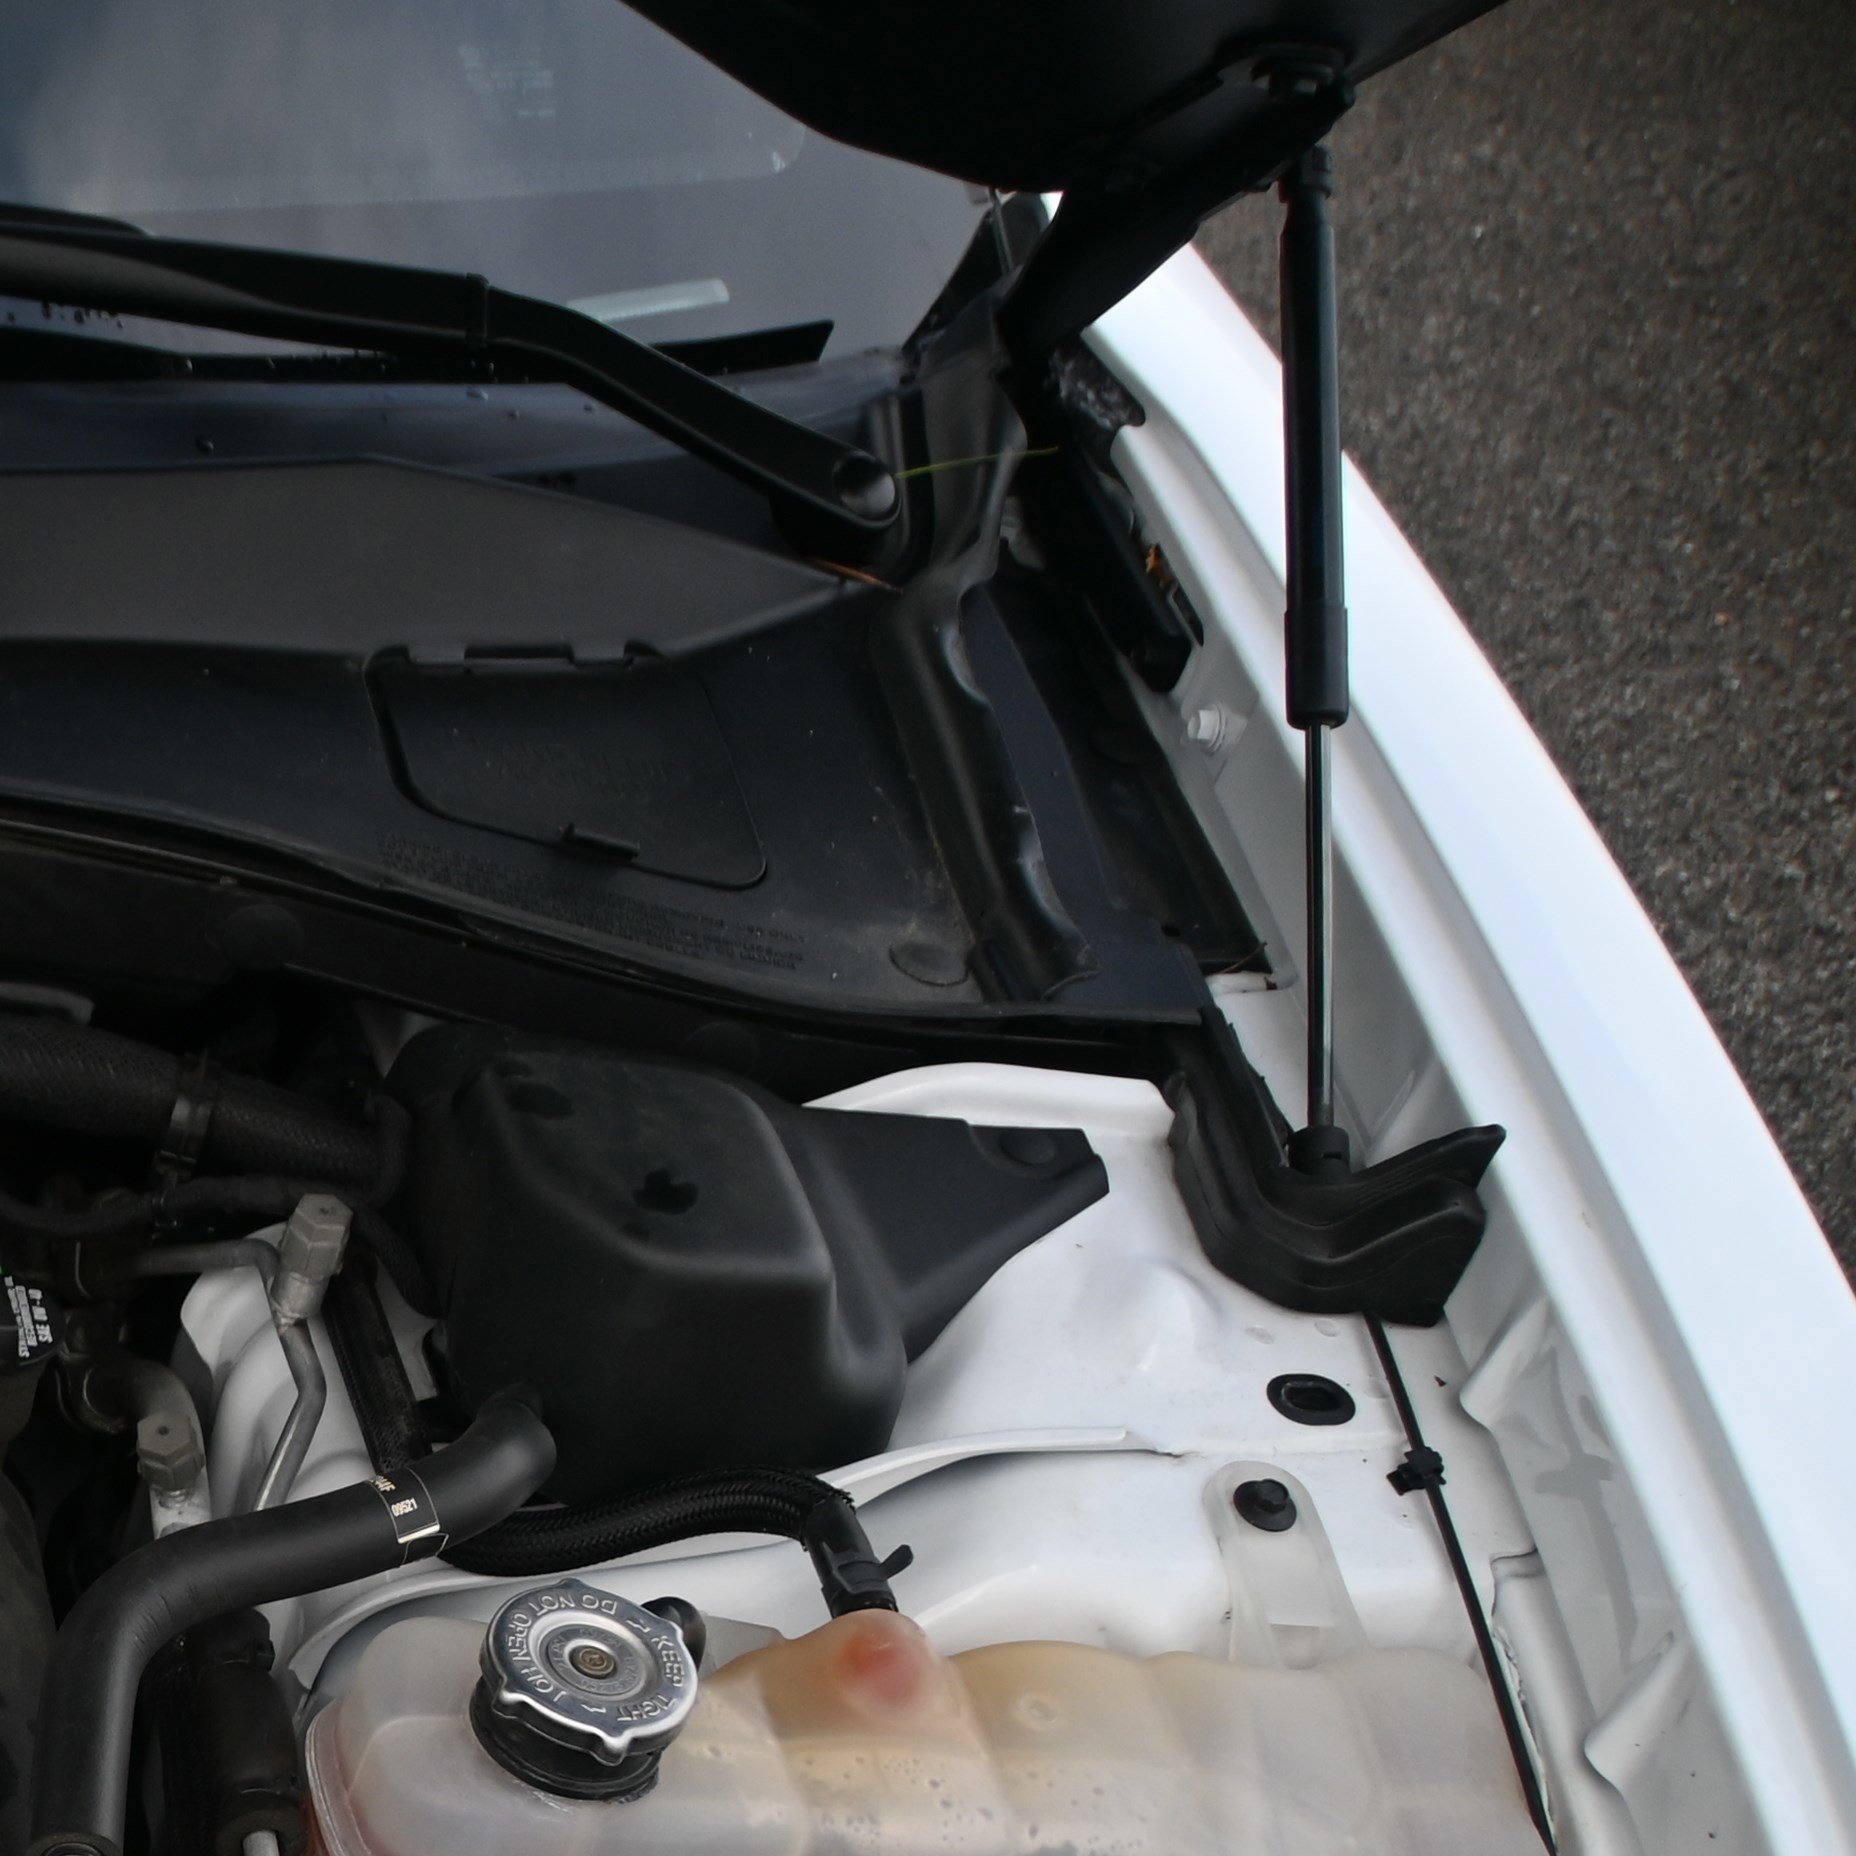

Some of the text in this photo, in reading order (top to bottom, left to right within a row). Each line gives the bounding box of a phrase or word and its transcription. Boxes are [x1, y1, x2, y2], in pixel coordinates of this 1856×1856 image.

[529, 1595, 576, 1616] NOT
[582, 1595, 617, 1614] DO
[617, 1635, 685, 1722] KEEP TIGHT
